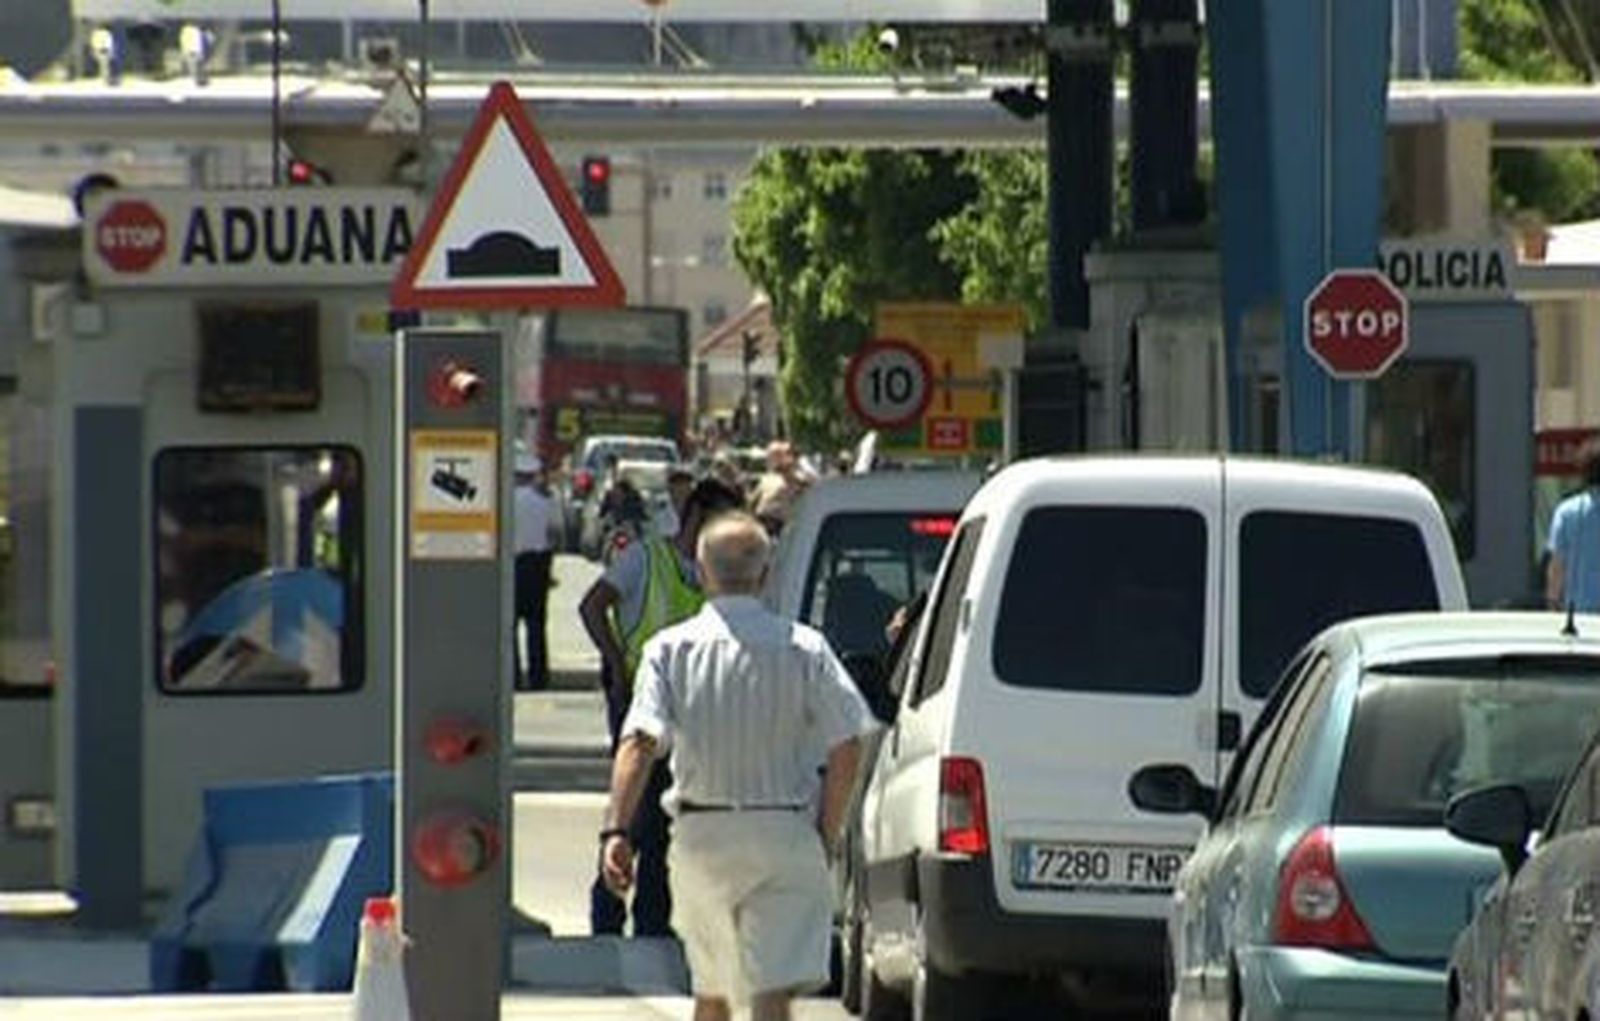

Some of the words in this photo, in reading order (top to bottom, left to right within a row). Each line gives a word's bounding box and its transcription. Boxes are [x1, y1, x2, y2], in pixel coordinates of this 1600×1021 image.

[101, 224, 162, 248] STOP
[180, 206, 414, 265] ADUANA
[1312, 309, 1400, 338] STOP
[869, 365, 913, 405] 10
[1036, 848, 1110, 882] 7280
